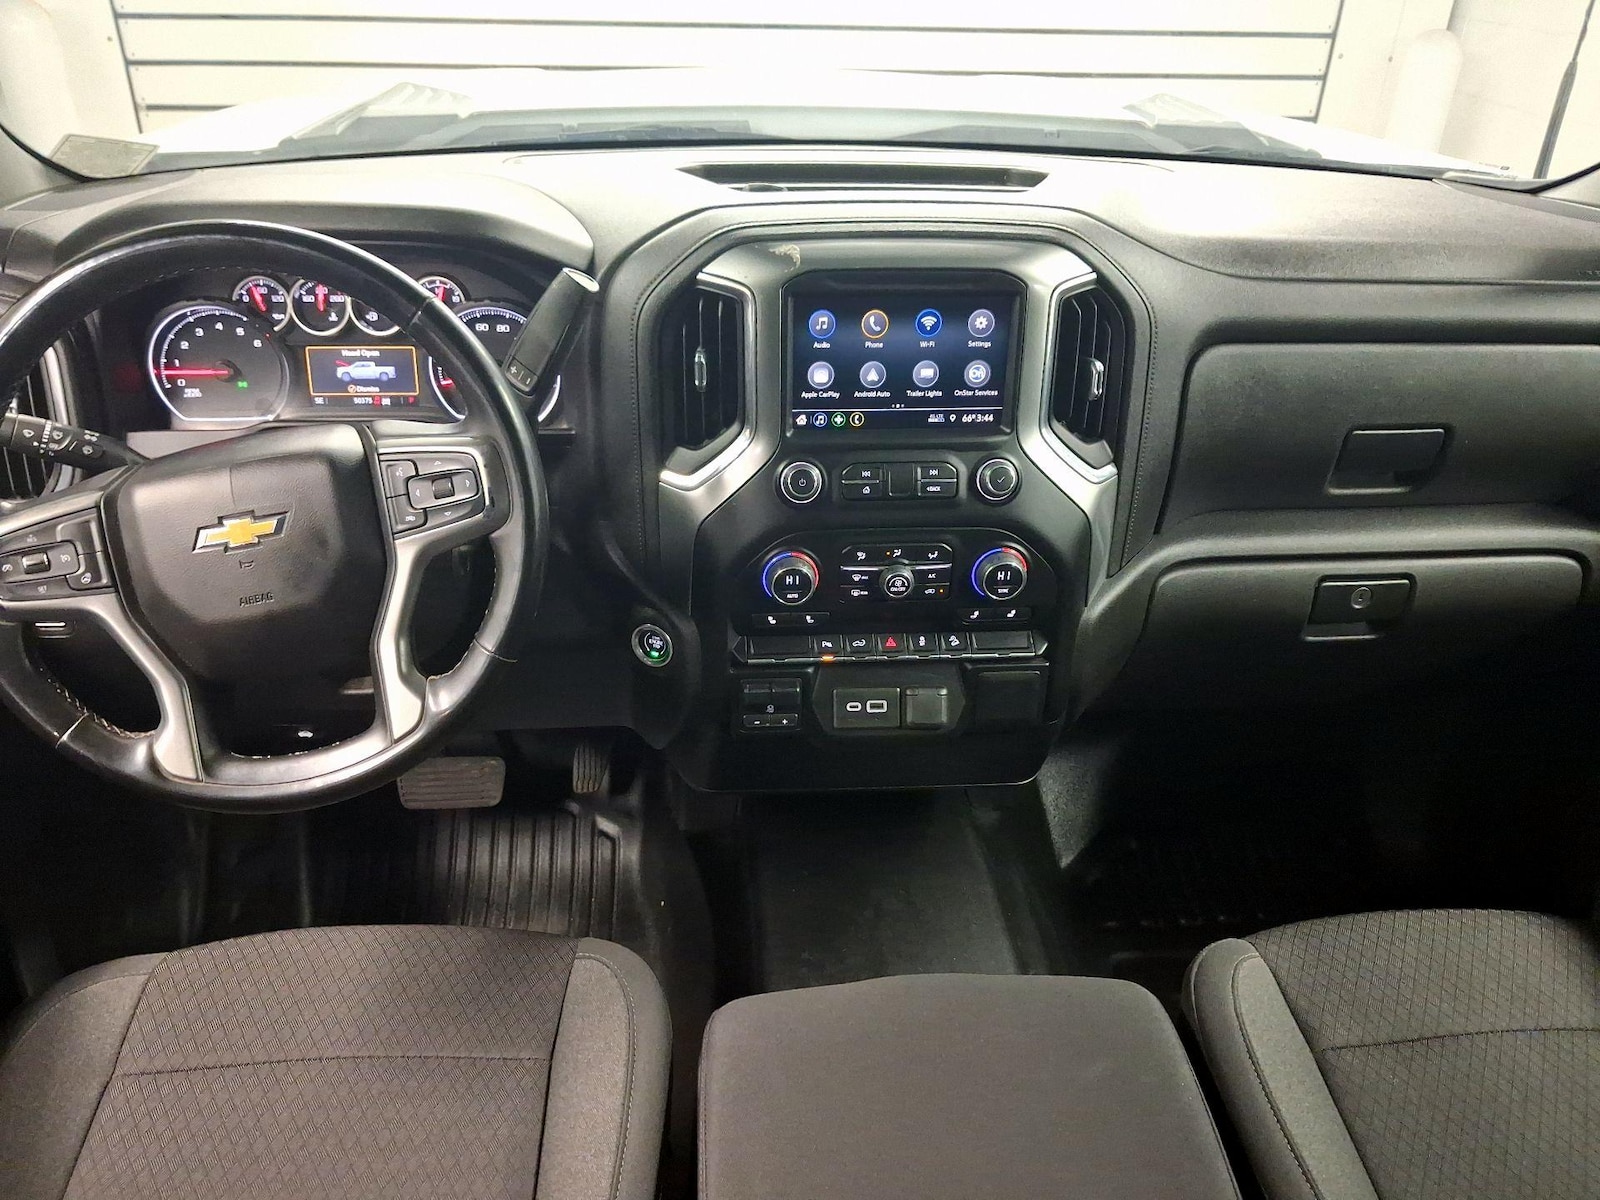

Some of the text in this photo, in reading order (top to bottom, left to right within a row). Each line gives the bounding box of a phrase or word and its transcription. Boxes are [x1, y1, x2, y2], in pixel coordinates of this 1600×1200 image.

[215, 322, 223, 331] 4
[475, 323, 489, 331] 60
[496, 324, 510, 332] 80
[195, 328, 204, 336] 3
[235, 327, 245, 336] 5
[180, 341, 189, 350] 2
[253, 340, 262, 348] 6
[813, 341, 831, 349] Audio
[864, 341, 883, 349] Phone
[919, 340, 935, 348] Wi-Fi
[967, 340, 992, 349] Settings
[361, 349, 380, 358] Open
[801, 391, 841, 399] Apple CarPlay
[854, 390, 891, 398] Android Auto
[925, 390, 943, 398] Lights
[975, 413, 994, 423] 3:44
[997, 570, 1011, 581] HI
[785, 575, 800, 585] HI
[239, 592, 274, 607] AIRBAG
